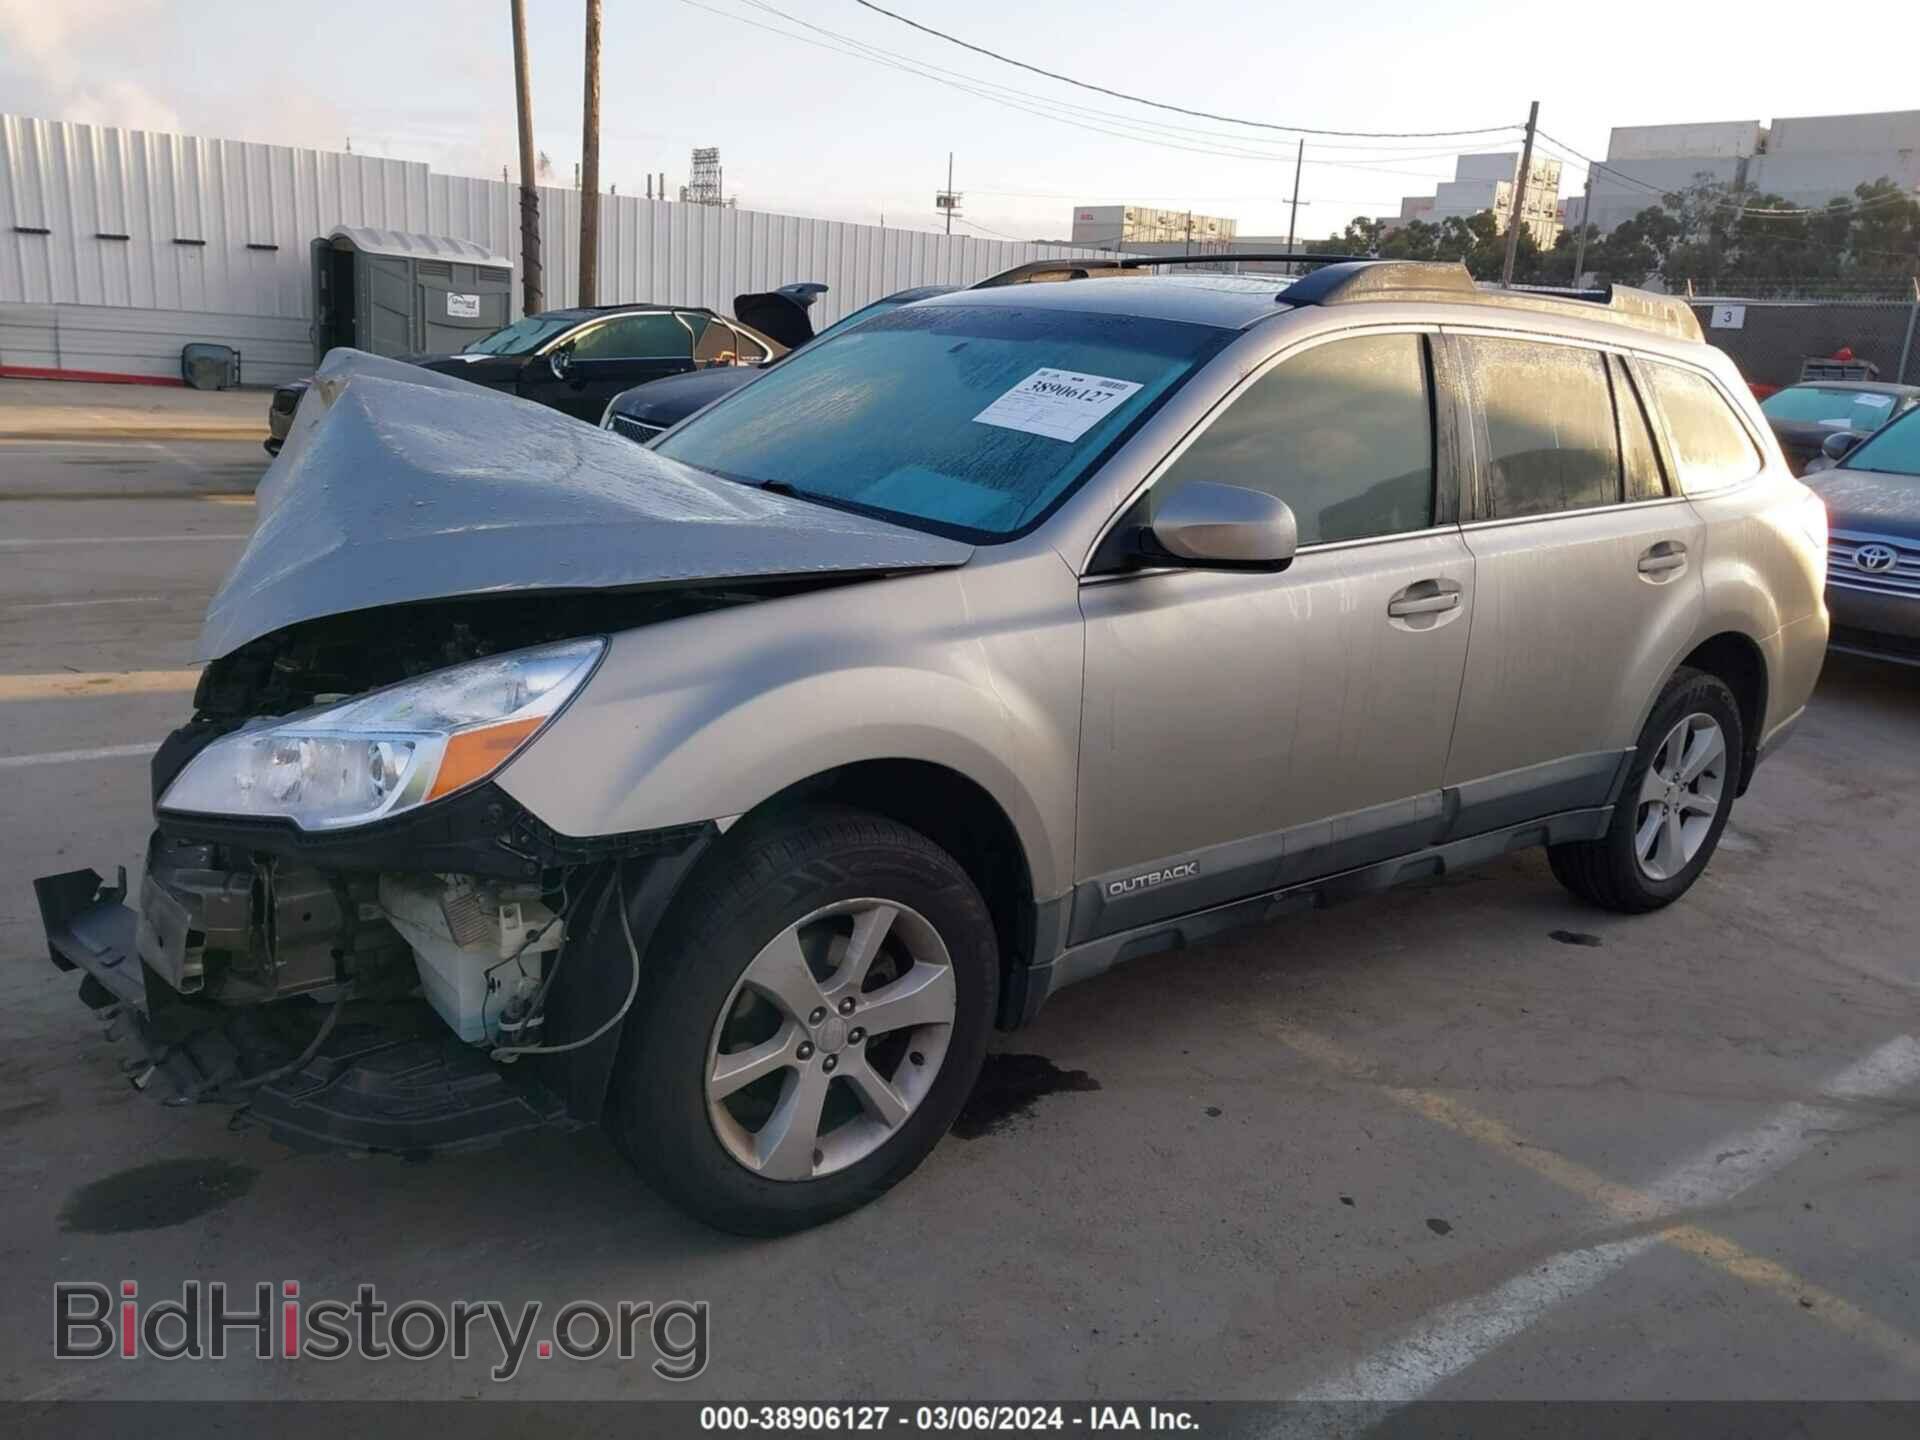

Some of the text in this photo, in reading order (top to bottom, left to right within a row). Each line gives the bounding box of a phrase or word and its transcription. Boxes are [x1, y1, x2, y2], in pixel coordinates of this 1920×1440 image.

[1724, 311, 1732, 323] 3
[1031, 380, 1115, 404] 38906127
[1109, 862, 1197, 896] OUTBACK
